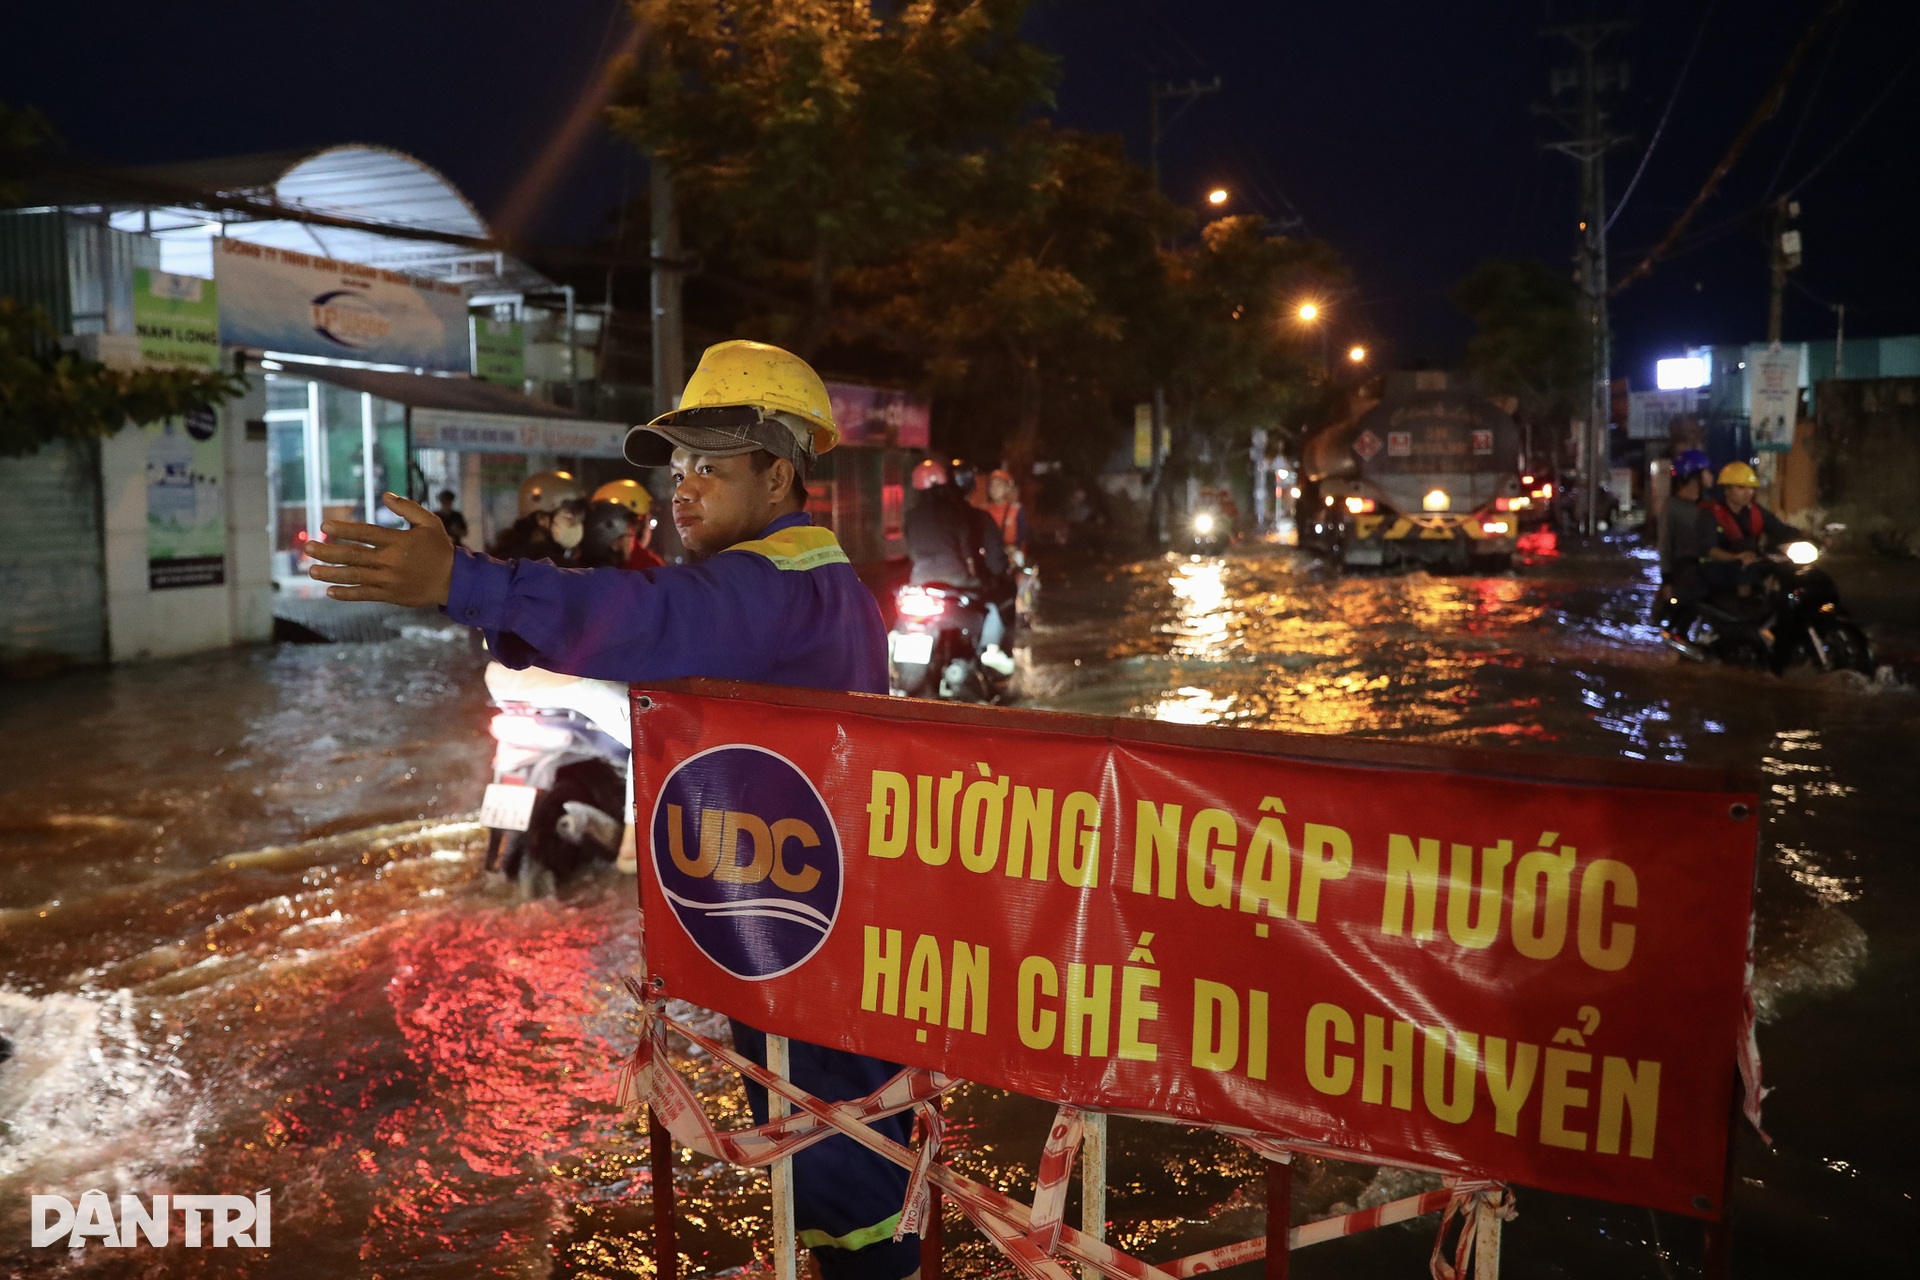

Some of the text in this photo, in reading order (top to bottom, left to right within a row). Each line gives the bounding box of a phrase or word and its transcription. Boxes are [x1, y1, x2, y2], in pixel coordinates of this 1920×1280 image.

[136, 323, 218, 345] NAM LONG
[667, 803, 822, 893] UDC
[867, 762, 1639, 972] ĐƯỜNG NGẬP NƯỚC
[862, 926, 1661, 1159] HẠN CHẾ DI CHUYỂN
